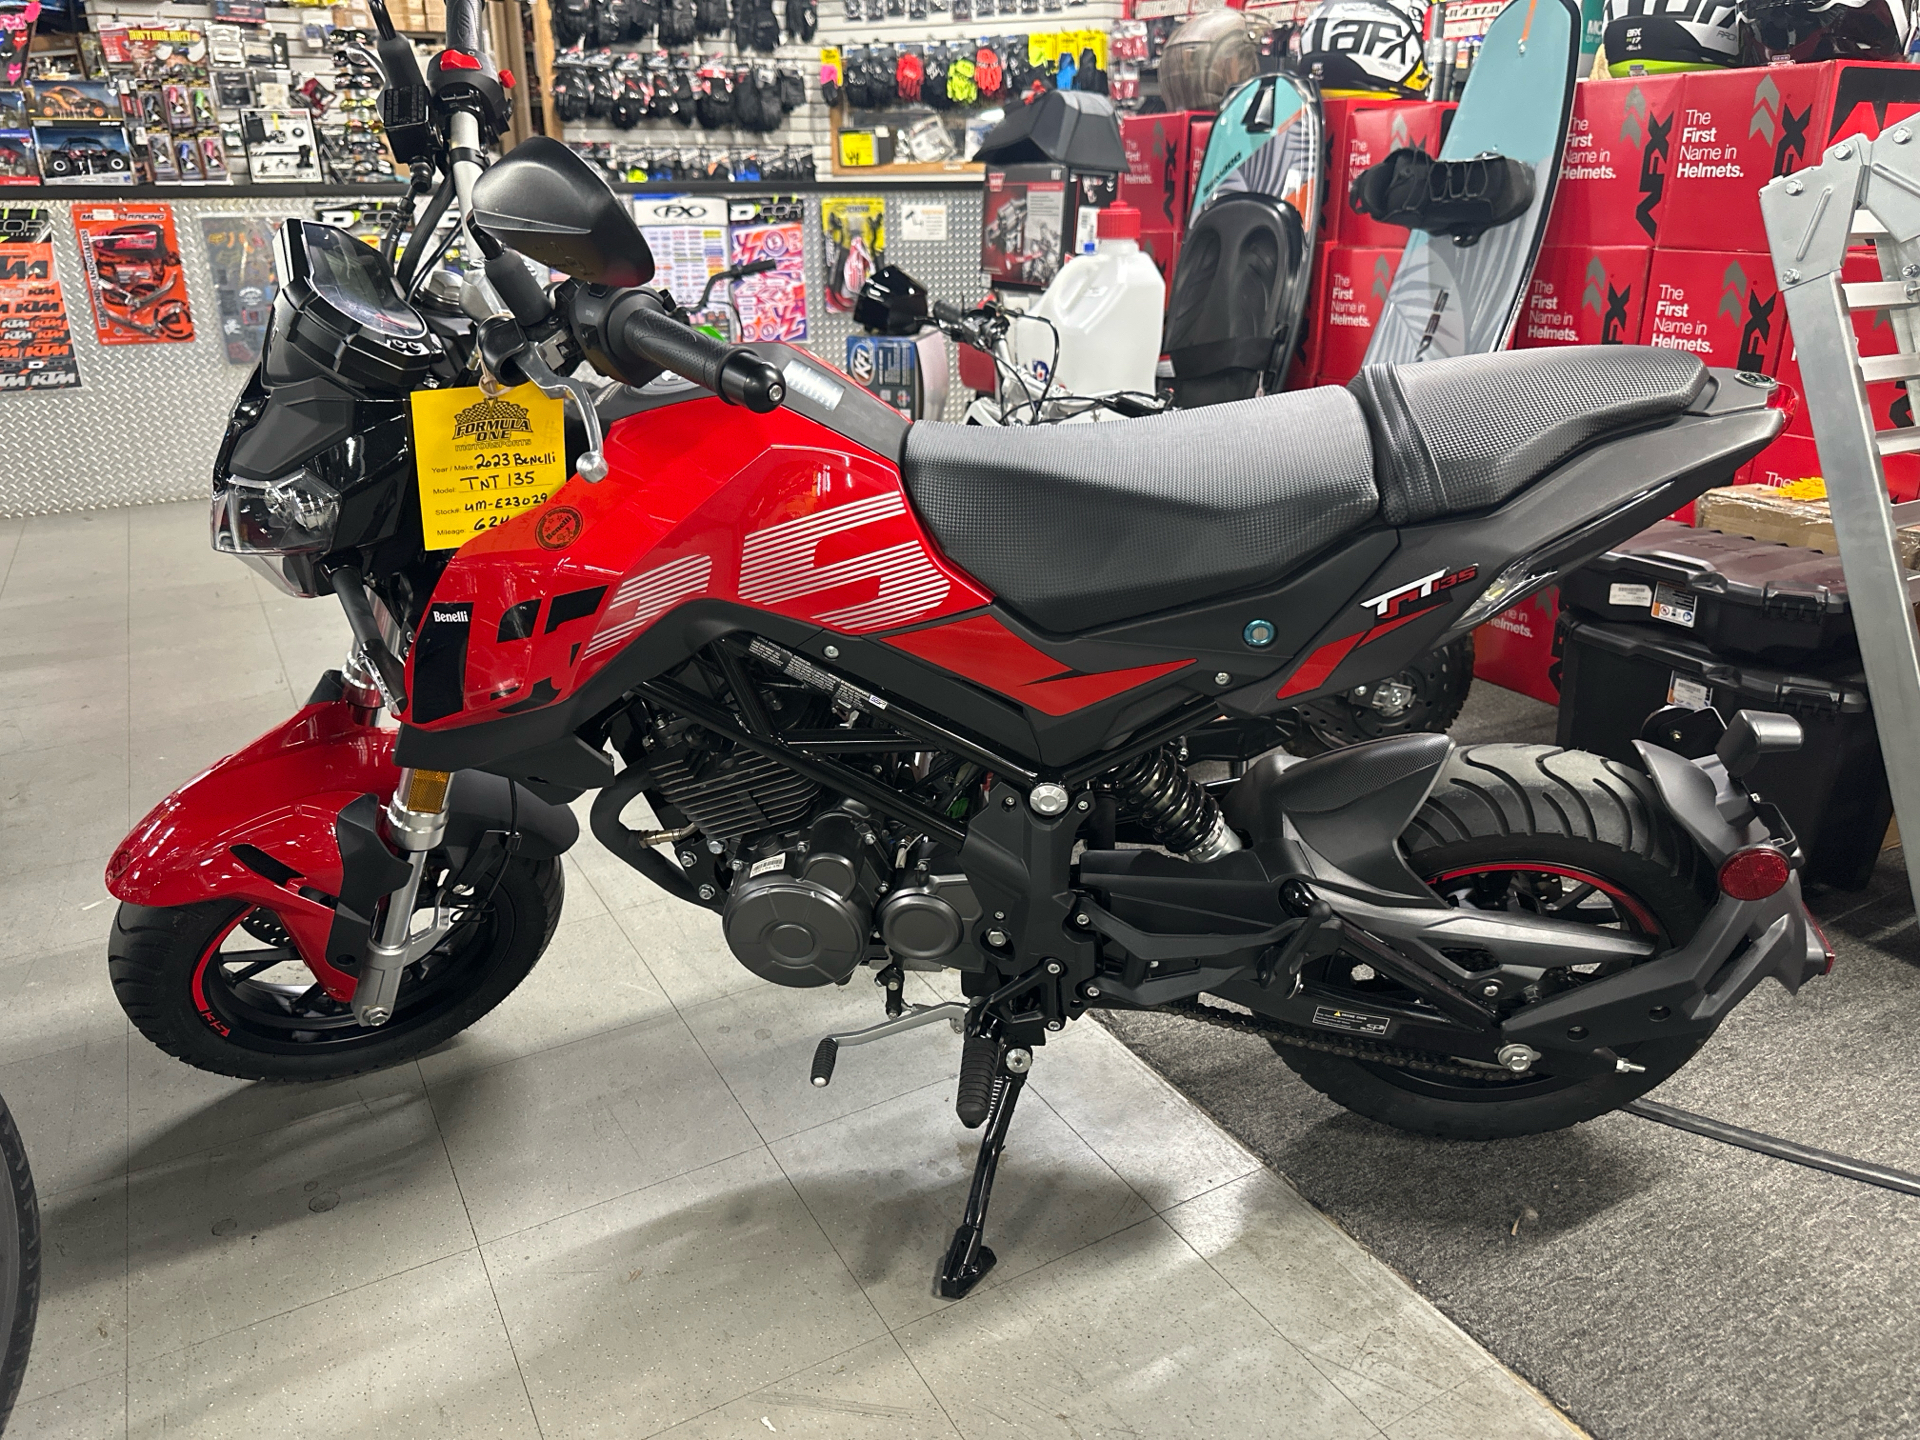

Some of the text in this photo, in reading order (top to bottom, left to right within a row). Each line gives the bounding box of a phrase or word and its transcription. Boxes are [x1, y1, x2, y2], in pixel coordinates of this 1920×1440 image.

[1685, 109, 1711, 125] The
[1566, 133, 1593, 148] First
[1682, 127, 1716, 143] First
[1351, 139, 1368, 152] The
[1679, 143, 1737, 160] Name in
[1350, 152, 1371, 166] First
[1599, 148, 1611, 163] in
[1560, 165, 1617, 180] Helmets.
[1676, 162, 1745, 179] Helmets.
[1334, 273, 1350, 287] The
[1533, 280, 1554, 294] The
[1332, 287, 1354, 300] First
[1659, 284, 1684, 300] The
[15, 301, 59, 313] KTM
[1331, 299, 1366, 313] Name in
[1530, 295, 1558, 310] First
[1656, 301, 1689, 317] First
[2, 318, 30, 329] KTM
[1330, 313, 1372, 328] Helmets.
[1529, 310, 1574, 326] Name in
[1527, 325, 1580, 342] Helmets.
[1653, 317, 1707, 336] Name in
[4, 330, 33, 340] KTM
[24, 342, 69, 358] KTM
[1651, 333, 1714, 354] Helmets.
[31, 371, 76, 386] KTM
[453, 418, 533, 440] FORMULA
[475, 430, 512, 442] ONE
[432, 466, 449, 474] Year
[474, 453, 510, 470] 2023
[460, 474, 499, 491] TNT
[508, 471, 535, 486] 135
[546, 515, 572, 541] Benelli
[433, 610, 469, 623] Benelli
